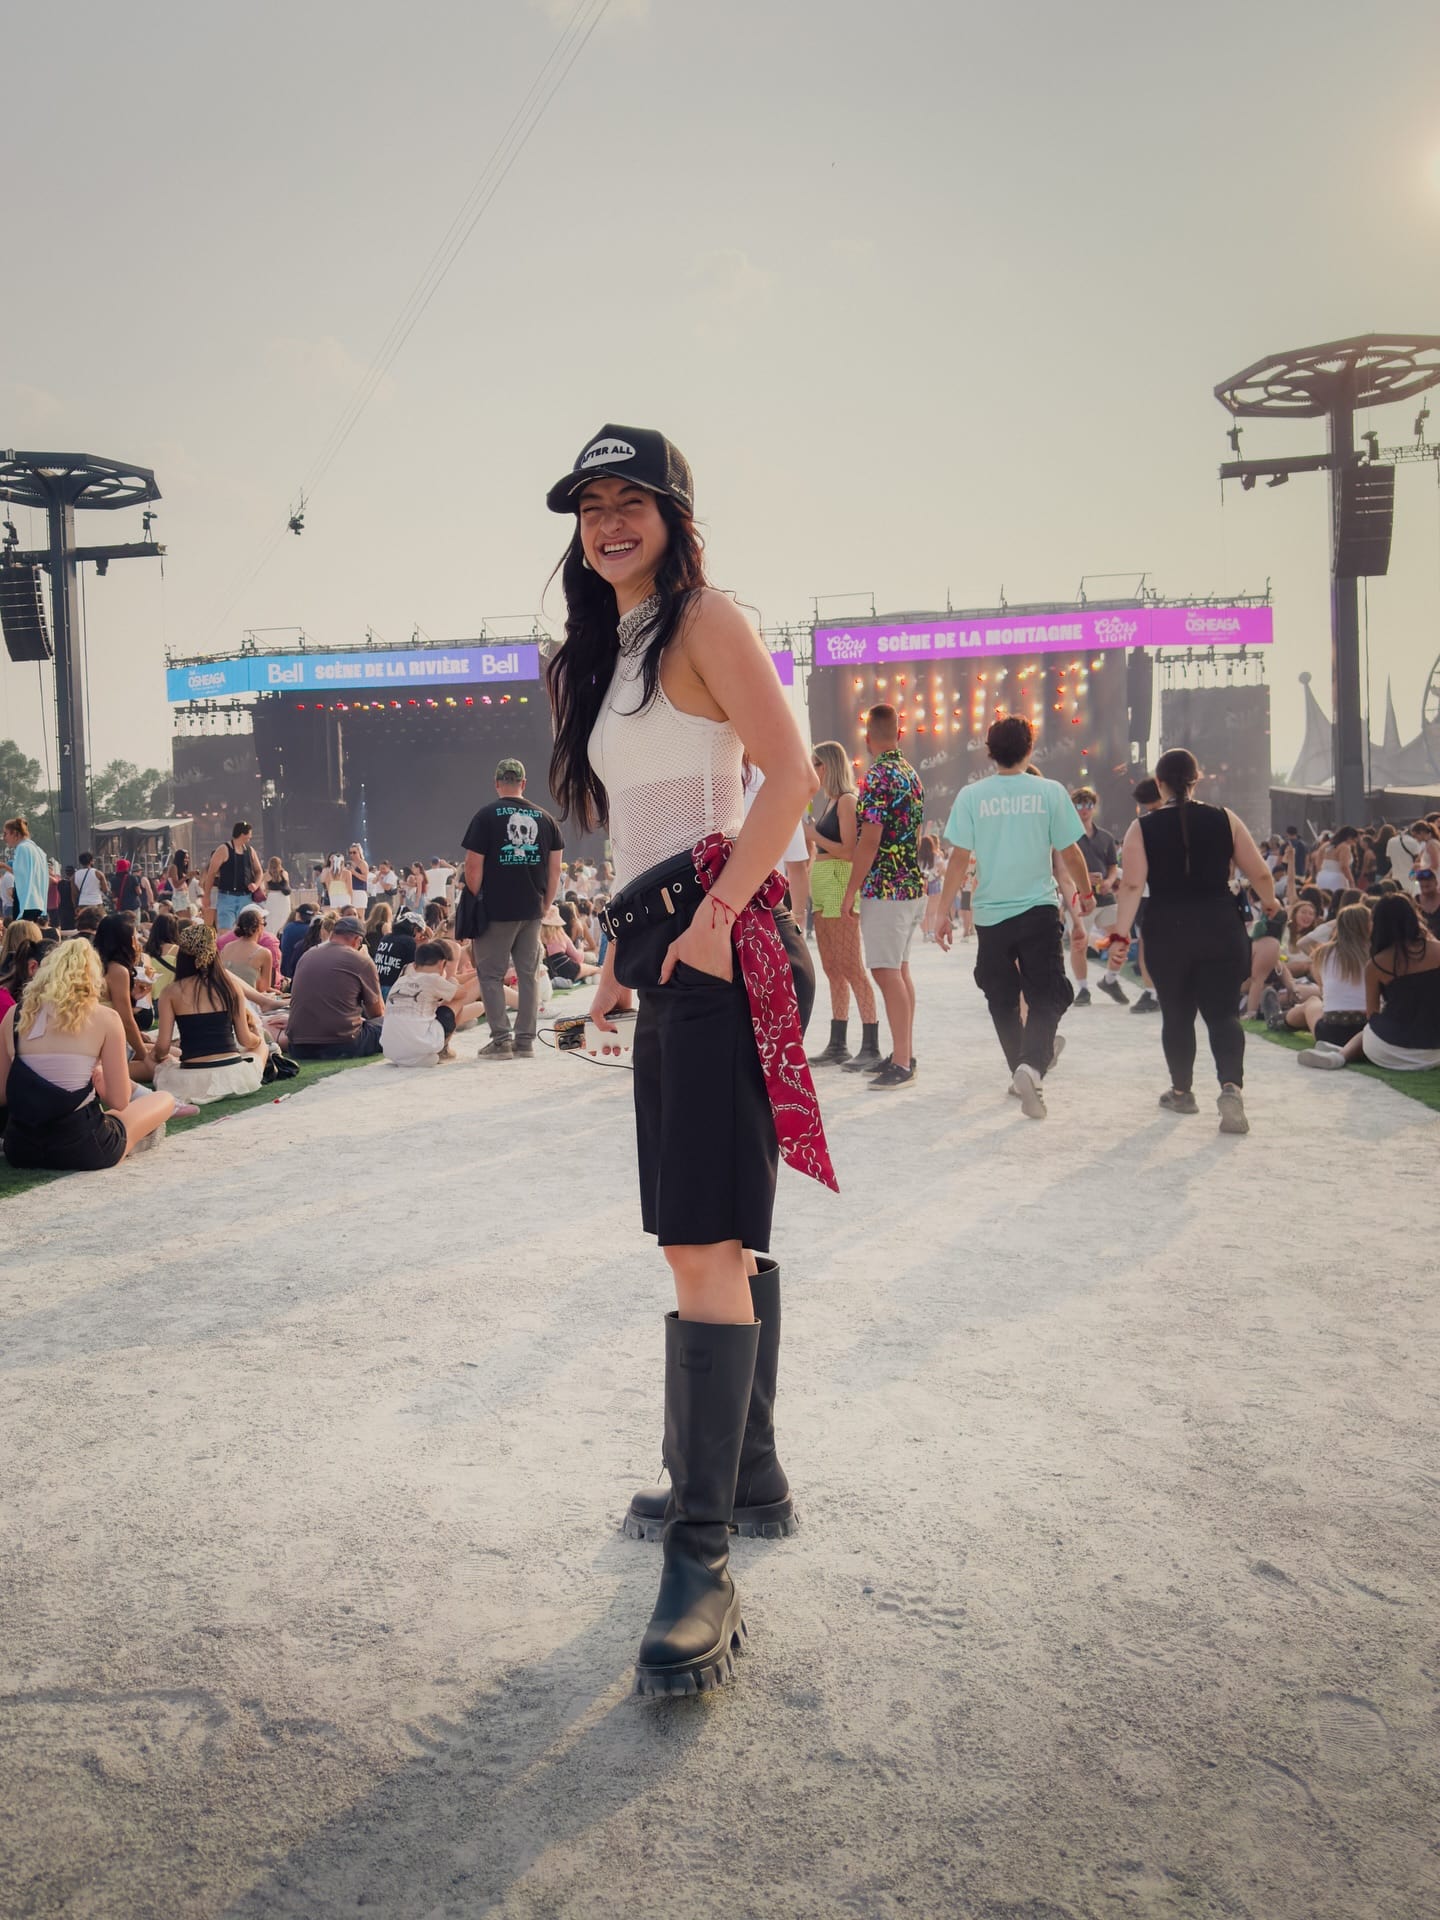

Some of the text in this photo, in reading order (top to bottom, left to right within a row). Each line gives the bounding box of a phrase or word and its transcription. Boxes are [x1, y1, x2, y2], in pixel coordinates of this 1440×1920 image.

[611, 445, 633, 455] ALL
[1093, 616, 1137, 634] Coors
[1185, 617, 1241, 633] OSHEAGA
[826, 633, 867, 651] Coors
[934, 632, 956, 649] DE
[959, 630, 982, 648] LA
[985, 623, 1083, 646] MONTAGNE
[1099, 632, 1133, 643] LIGHT
[831, 650, 863, 659] LIGHT
[365, 663, 384, 678] DE
[386, 661, 406, 677] LA
[409, 656, 470, 676] RIVIÈRE
[482, 653, 519, 675] Bell
[267, 662, 304, 684] Bell
[63, 743, 71, 756] 2
[496, 807, 543, 818] EAST COAST
[979, 794, 1047, 818] ACCUEIL
[387, 942, 394, 952] I
[384, 955, 401, 969] LIKE
